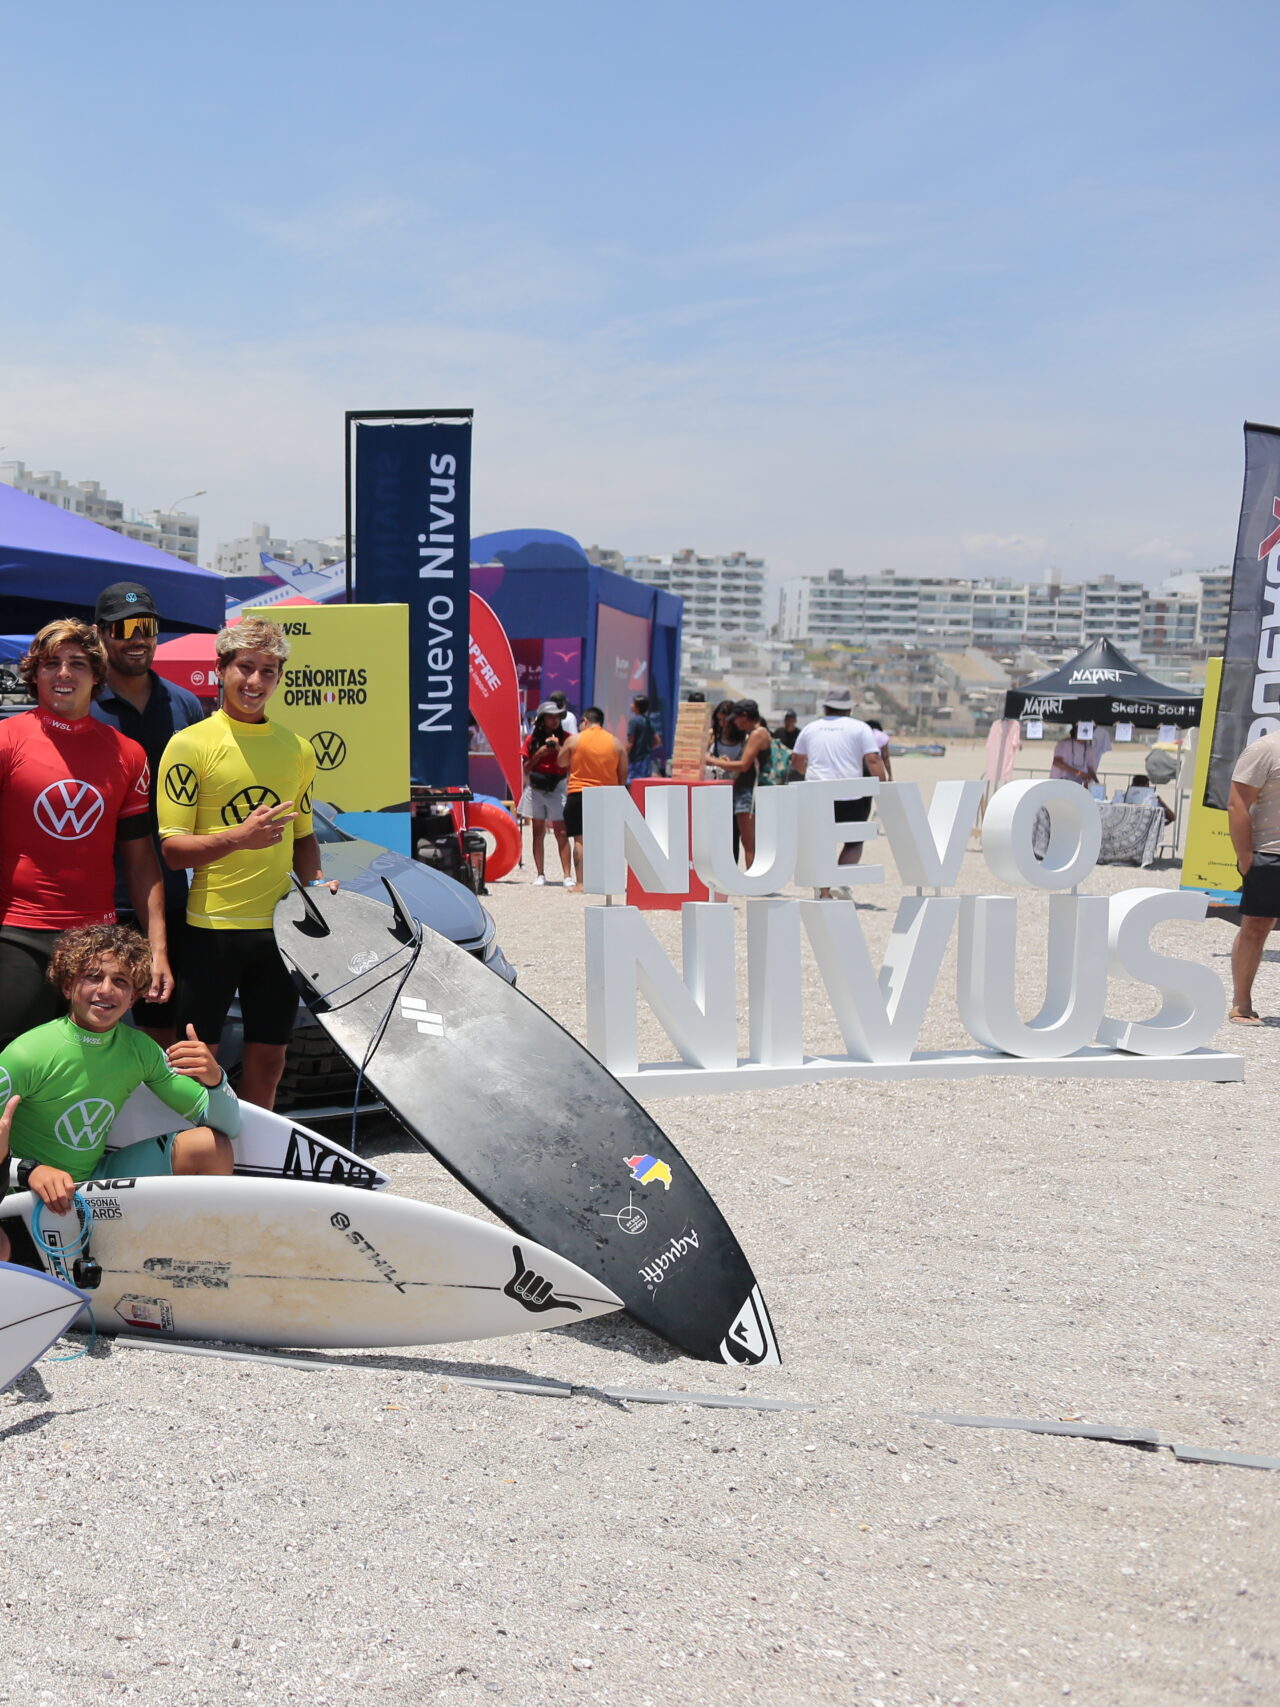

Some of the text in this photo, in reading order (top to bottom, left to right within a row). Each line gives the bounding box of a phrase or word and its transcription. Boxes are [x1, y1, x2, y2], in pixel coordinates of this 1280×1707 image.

[418, 452, 457, 732] Nuevo Nivus
[281, 622, 312, 636] WSL
[284, 665, 368, 688] SEÑORITAS
[284, 688, 368, 707] OPEN PRO
[1111, 702, 1153, 715] Sketch
[1158, 704, 1185, 715] Soul
[52, 719, 73, 732] WSL
[582, 778, 1103, 896] NUEVO
[585, 888, 1228, 1073] NIVUS
[82, 1035, 102, 1045] WSL
[75, 1198, 120, 1207] PERSONAL
[91, 1207, 123, 1219] ARDS
[638, 1229, 700, 1283] Aquafit
